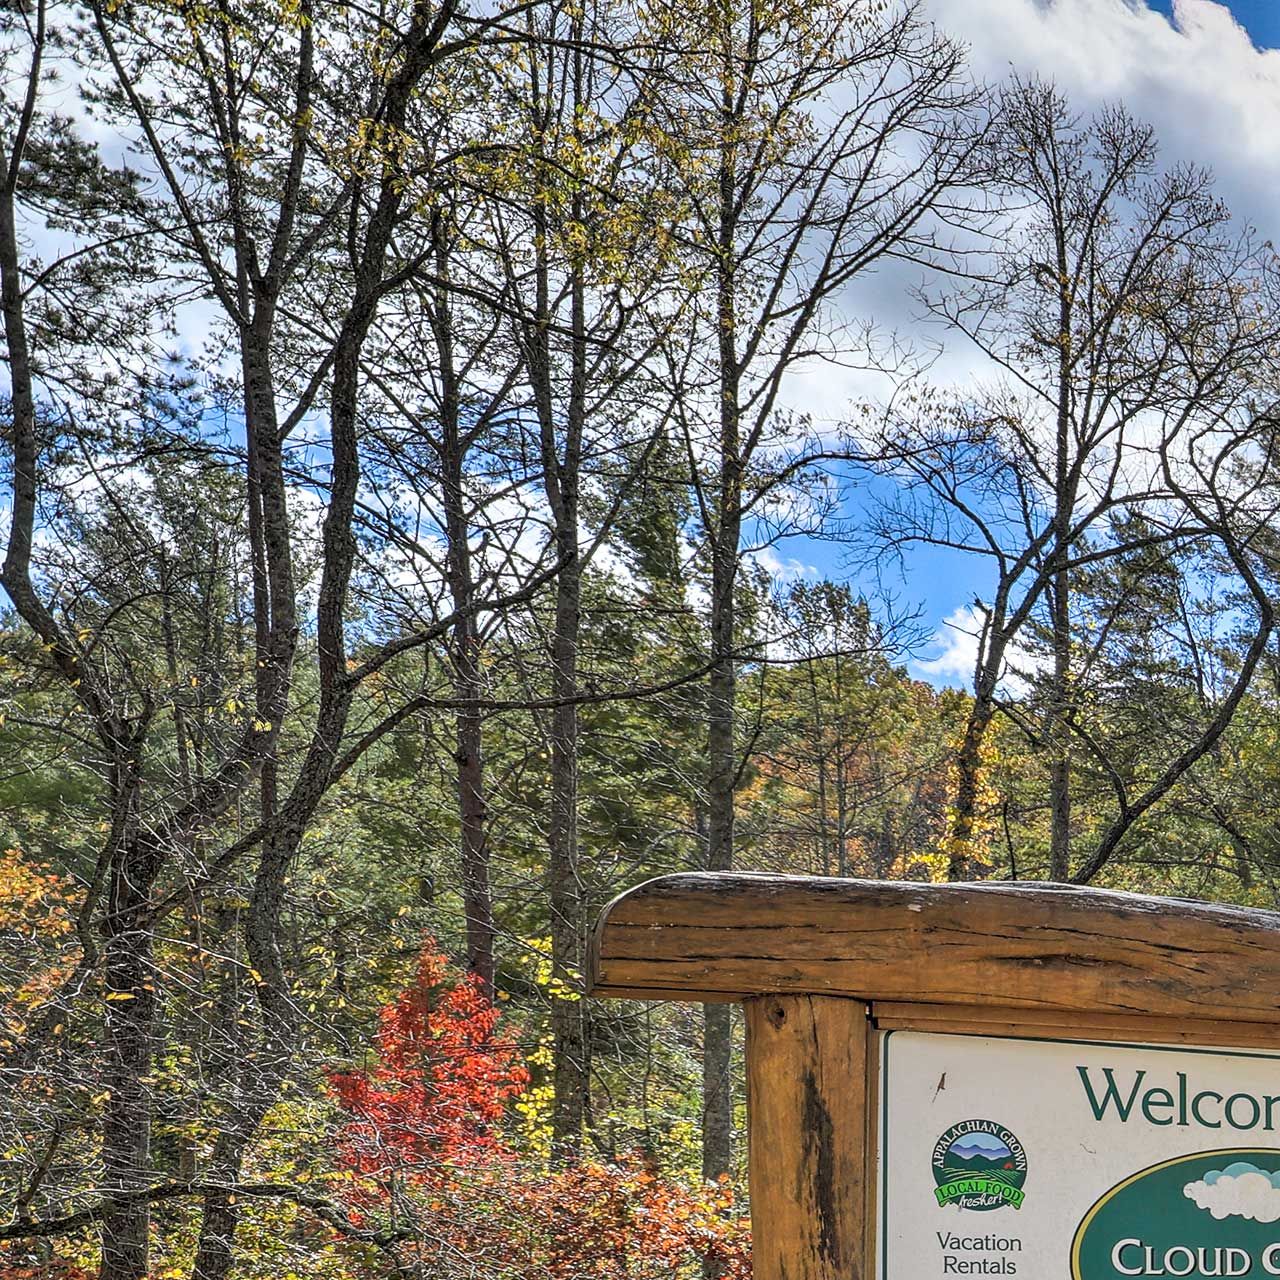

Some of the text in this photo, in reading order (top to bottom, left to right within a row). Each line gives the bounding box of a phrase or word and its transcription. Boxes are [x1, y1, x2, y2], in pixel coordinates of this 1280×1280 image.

[933, 1121, 1026, 1171] APPALACHIAN GROWN
[940, 1182, 1020, 1201] LOCAL FOOD
[959, 1192, 1002, 1211] fresher!
[937, 1232, 1022, 1251] Vacation
[943, 1256, 1017, 1274] Rentals
[1111, 1238, 1251, 1277] CLOUD
